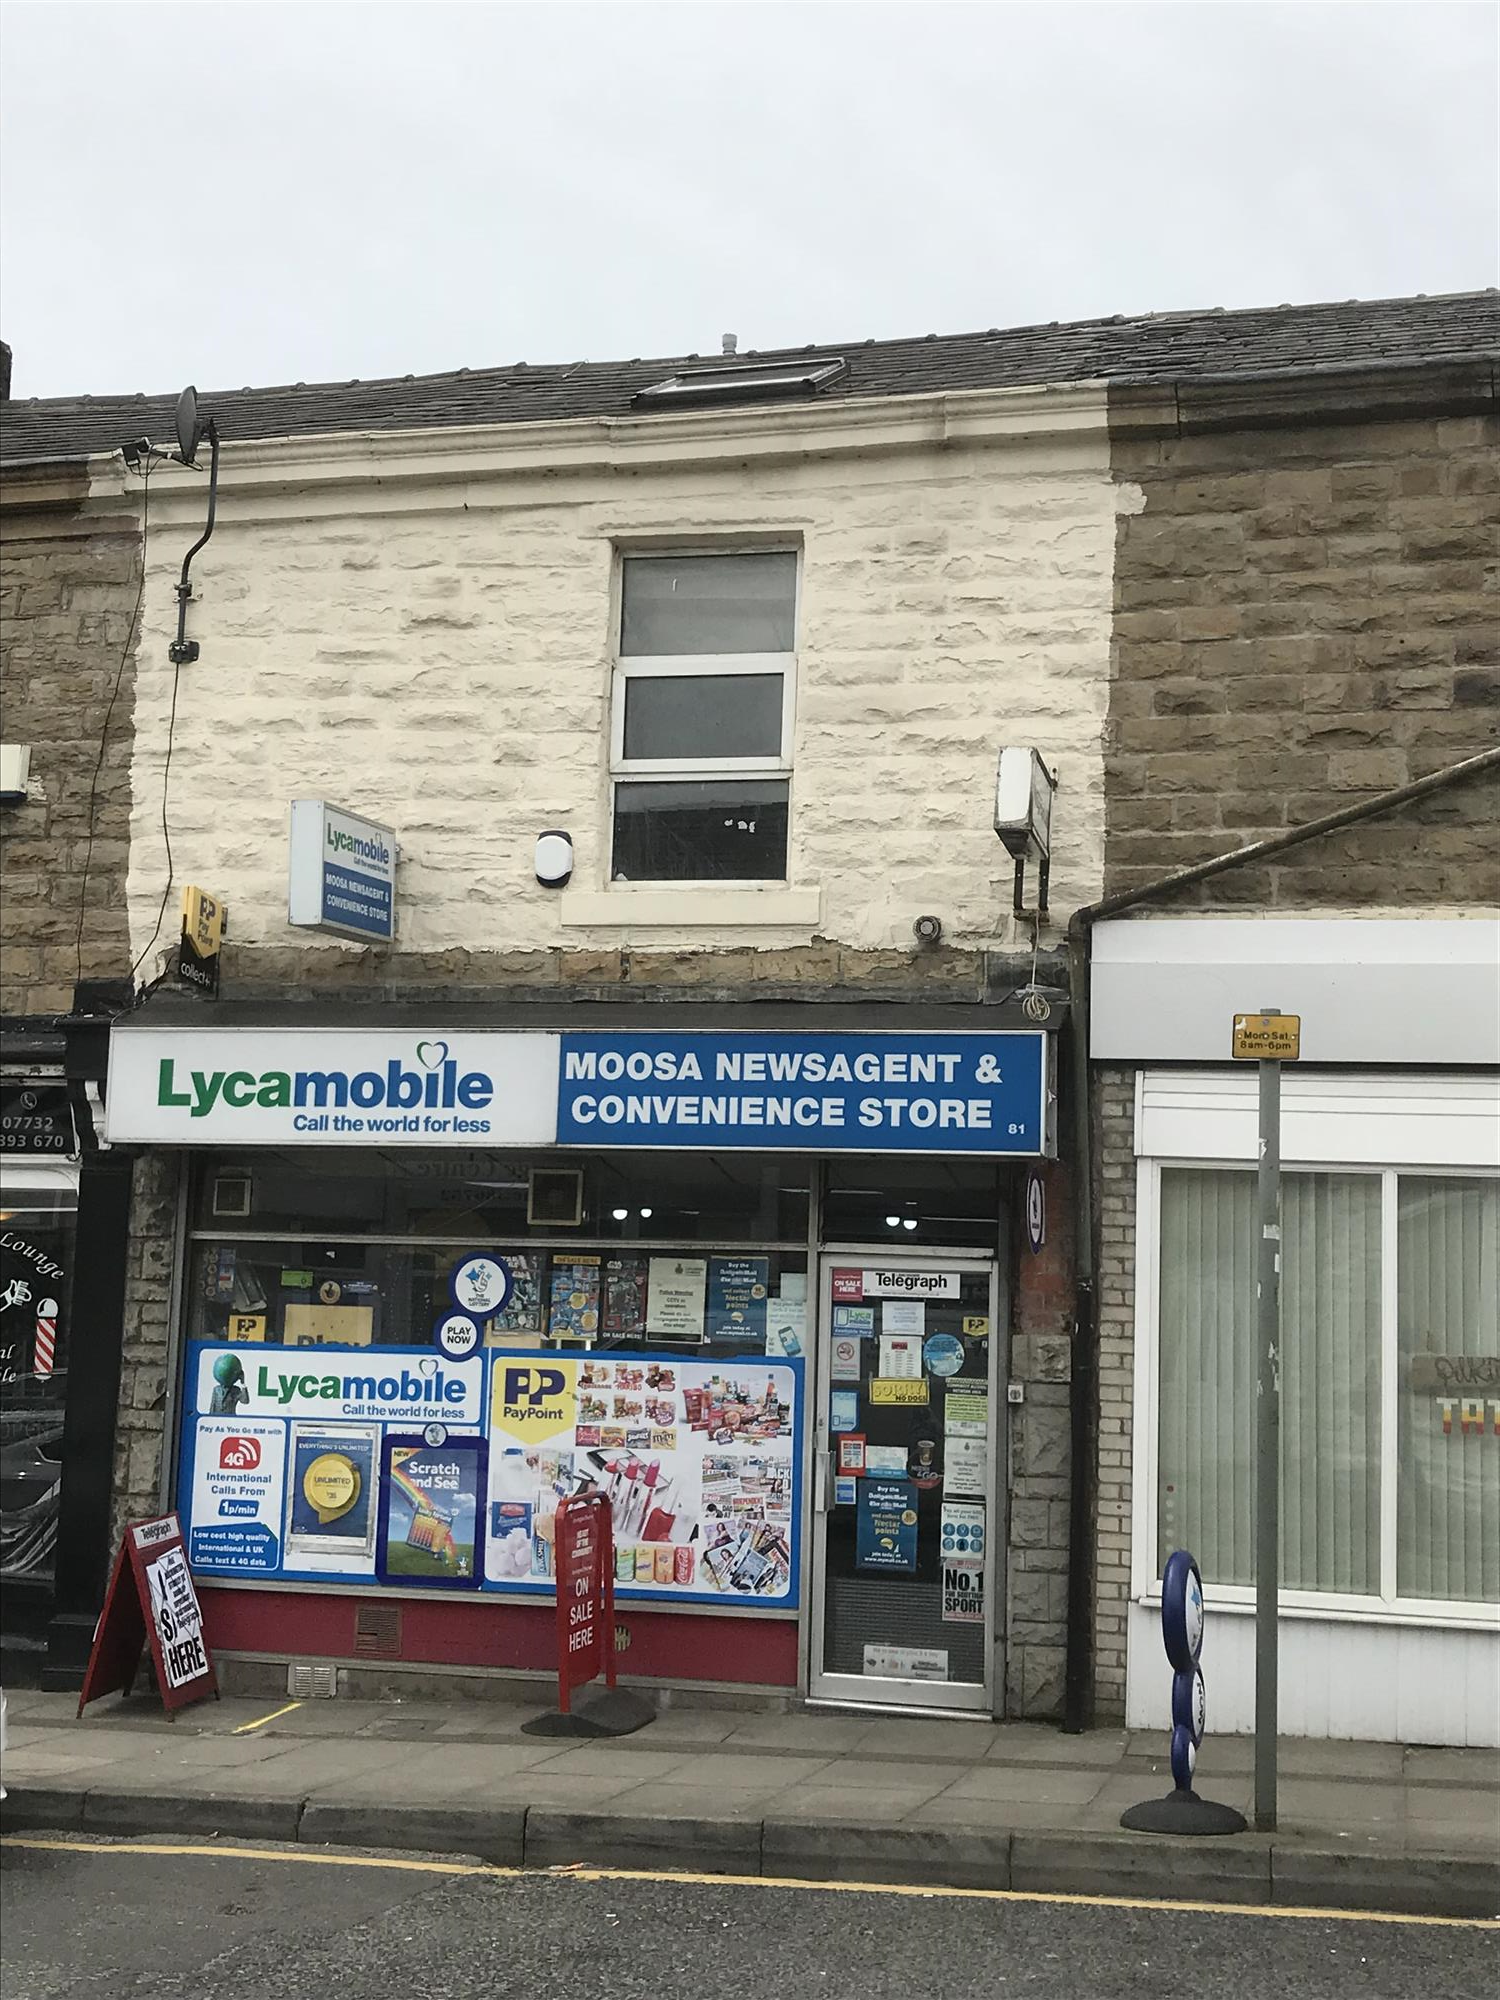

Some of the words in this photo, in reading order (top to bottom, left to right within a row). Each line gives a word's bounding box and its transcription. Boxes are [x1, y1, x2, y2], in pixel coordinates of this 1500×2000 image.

[327, 822, 389, 864] Lycamobile
[326, 873, 348, 890] MOOSA
[348, 880, 384, 901] NEWSAGENT
[326, 894, 369, 917] CONVENIENCE
[369, 905, 389, 921] STORE
[1240, 1041, 1291, 1052] 8am-6pm
[565, 1051, 703, 1082] MOOSA
[715, 1052, 962, 1083] NEWSAGENT
[974, 1053, 1003, 1084] &
[157, 1058, 494, 1117] Lycamobile
[571, 1094, 846, 1126] CONVENIENCE
[858, 1097, 993, 1129] STORE
[3, 1116, 53, 1131] 07732
[293, 1114, 328, 1132] Call
[333, 1116, 364, 1132] the
[366, 1116, 420, 1133] world
[423, 1116, 451, 1133] for
[454, 1116, 491, 1134] less
[1008, 1123, 1025, 1135] 81
[34, 1134, 64, 1149] 670
[0, 1232, 64, 1280] Lounge
[876, 1272, 947, 1291] Telegraph
[850, 1309, 872, 1319] Lyca
[238, 1318, 257, 1331] PP
[447, 1326, 472, 1335] PLAY
[447, 1335, 472, 1344] NOW
[257, 1365, 467, 1404] Lycamobile
[504, 1368, 566, 1405] PP
[875, 1382, 924, 1398] SORRY
[342, 1403, 365, 1415] Call
[367, 1404, 387, 1415] the
[388, 1405, 421, 1417] world
[422, 1407, 440, 1418] for
[441, 1407, 465, 1419] less
[503, 1406, 564, 1423] PayPoint
[199, 1425, 213, 1434] Pay
[226, 1426, 240, 1434] You
[224, 1452, 245, 1467] 4G
[393, 1450, 410, 1458] NEW
[409, 1461, 461, 1476] Scratch
[206, 1472, 272, 1484] International
[315, 1476, 351, 1484] UNLIMITED
[433, 1476, 459, 1489] See
[211, 1485, 236, 1495] Calls
[239, 1486, 266, 1496] From
[222, 1501, 256, 1515] 1p/min
[875, 1519, 900, 1528] Nectar
[141, 1522, 172, 1541] Telegraph
[194, 1530, 209, 1538] Low
[210, 1532, 226, 1540] cost
[228, 1532, 244, 1542] high
[245, 1534, 271, 1543] quality
[875, 1527, 900, 1536] points
[198, 1543, 244, 1553] International
[252, 1545, 264, 1554] UK
[195, 1555, 212, 1564] Calls
[215, 1556, 229, 1564] text
[250, 1557, 267, 1566] data
[575, 1575, 589, 1598] ON
[945, 1569, 984, 1592] No.1
[570, 1600, 594, 1626] SALE
[945, 1597, 985, 1614] SPORT
[569, 1625, 594, 1653] HERE
[168, 1637, 206, 1681] HERE
